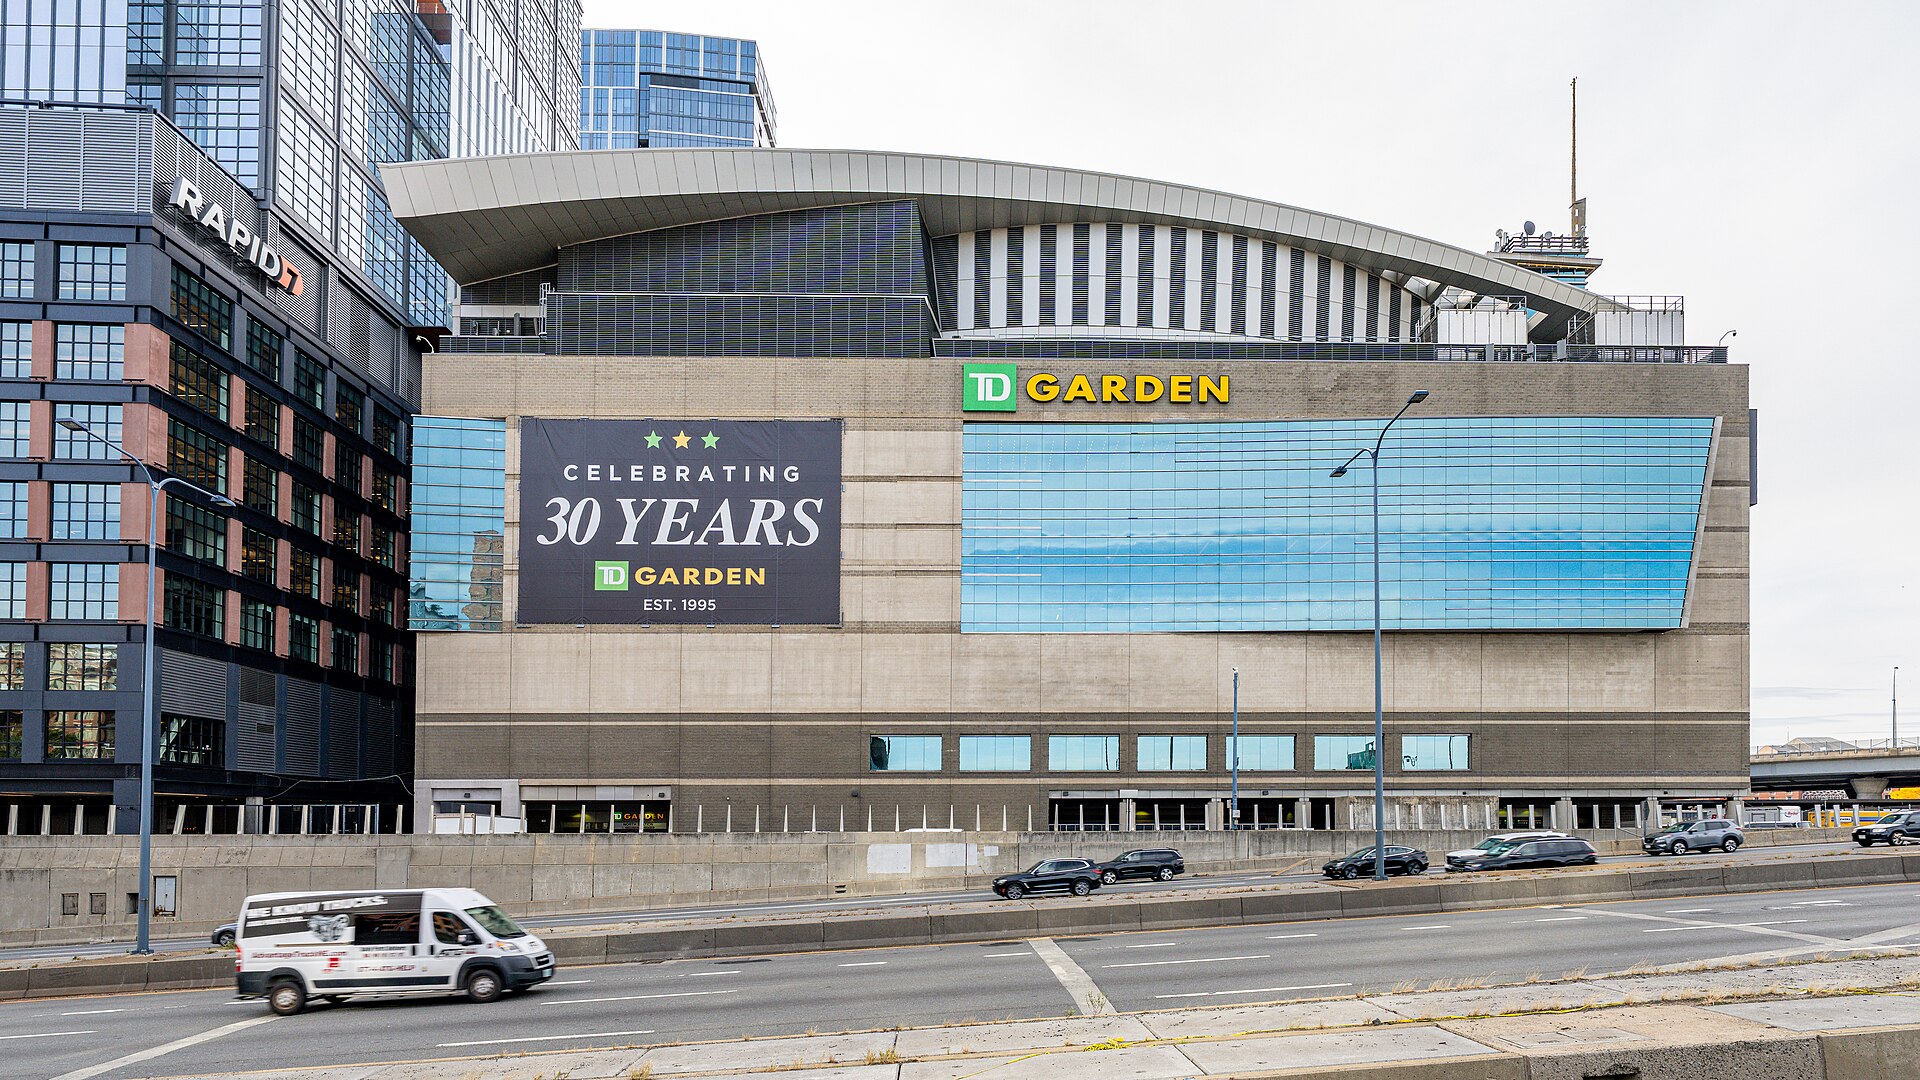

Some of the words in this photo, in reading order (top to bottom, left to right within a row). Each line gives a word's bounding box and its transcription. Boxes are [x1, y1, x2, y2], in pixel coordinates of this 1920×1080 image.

[967, 372, 1012, 402] TD
[1025, 373, 1230, 403] GARDEN
[563, 464, 800, 482] CELEBRATING
[536, 496, 601, 546] 30
[615, 497, 824, 547] YEARS
[634, 566, 766, 586] GARDEN
[643, 599, 677, 611] EST.
[681, 599, 716, 611] 1995
